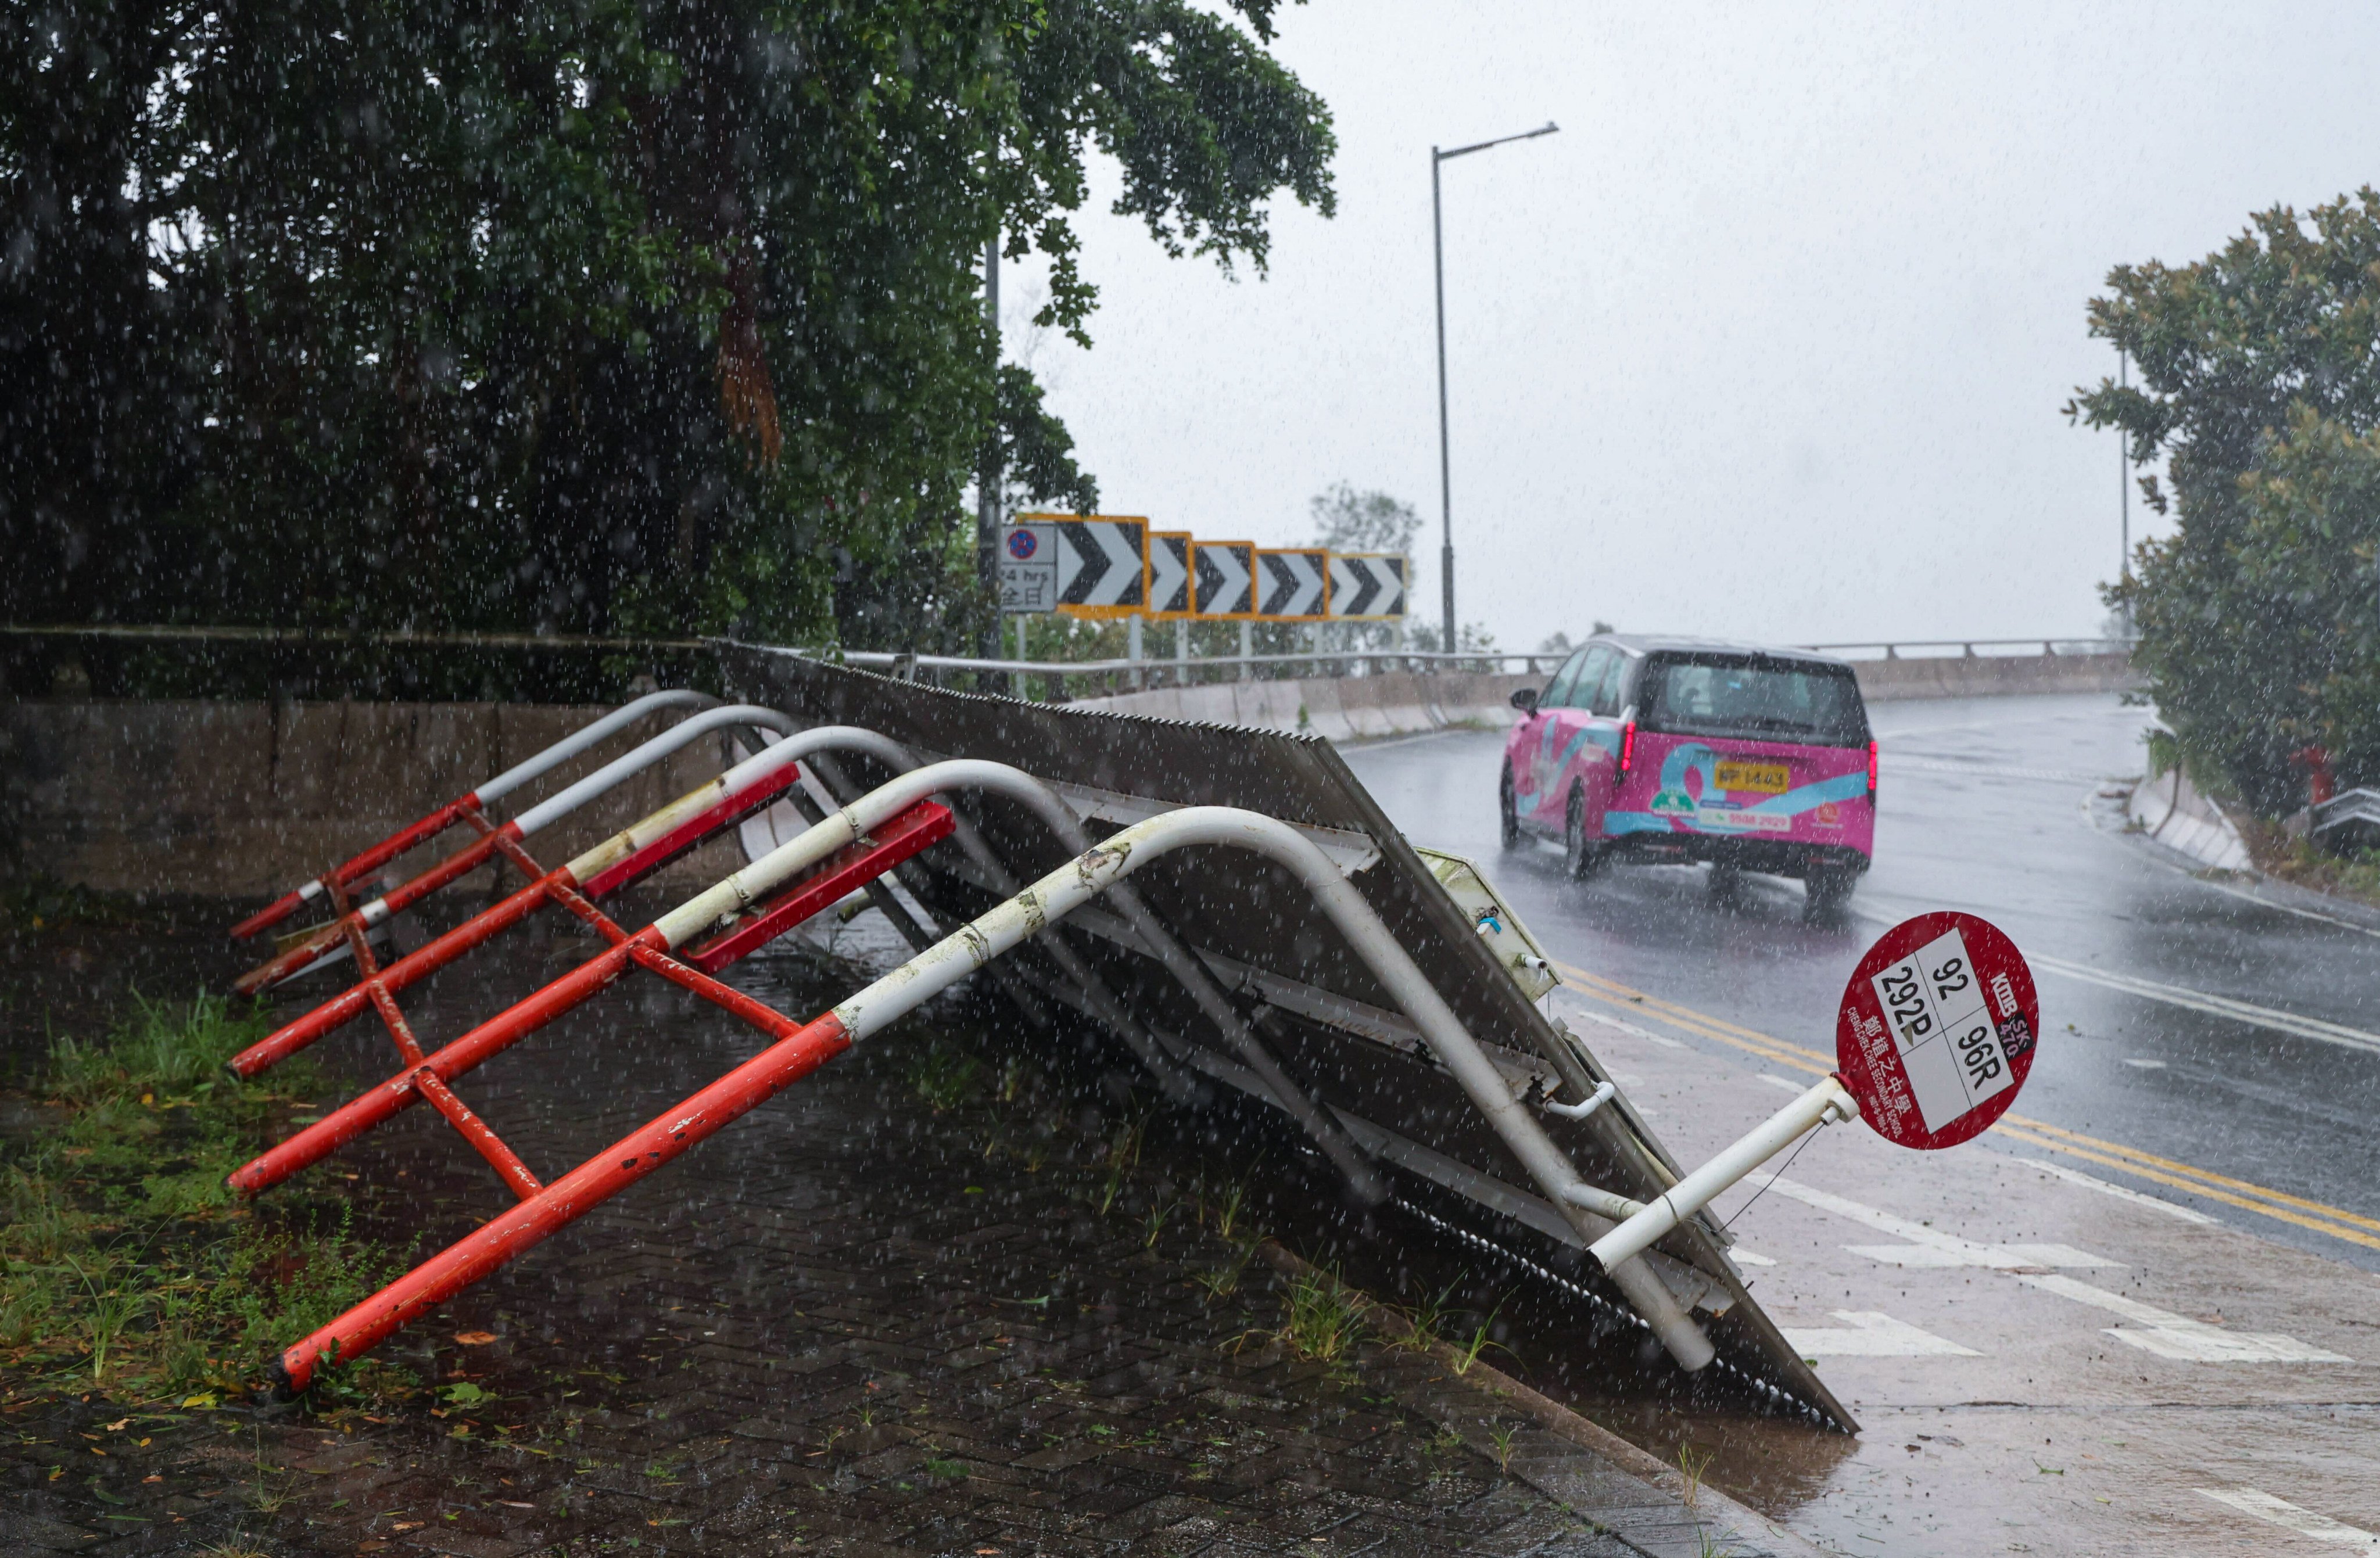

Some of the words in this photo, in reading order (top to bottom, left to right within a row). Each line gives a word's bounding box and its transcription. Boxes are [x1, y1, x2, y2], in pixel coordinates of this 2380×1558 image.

[1024, 569, 1048, 581] hrs
[1002, 587, 1041, 605] 全日
[1933, 957, 1969, 1001] 92
[1881, 967, 1932, 1037] 292P
[1846, 1006, 1863, 1031] CHENG
[2012, 1019, 2031, 1049] SK
[1855, 1030, 1870, 1051] CHEK
[1999, 1023, 2019, 1056] 470
[1862, 1049, 1878, 1070] CHEE
[1862, 1014, 1912, 1117] 鄭植之中學
[1958, 1025, 2001, 1091] 96R
[1870, 1068, 1893, 1110] SECONDARY
[1885, 1108, 1904, 1139] SCHOOL
